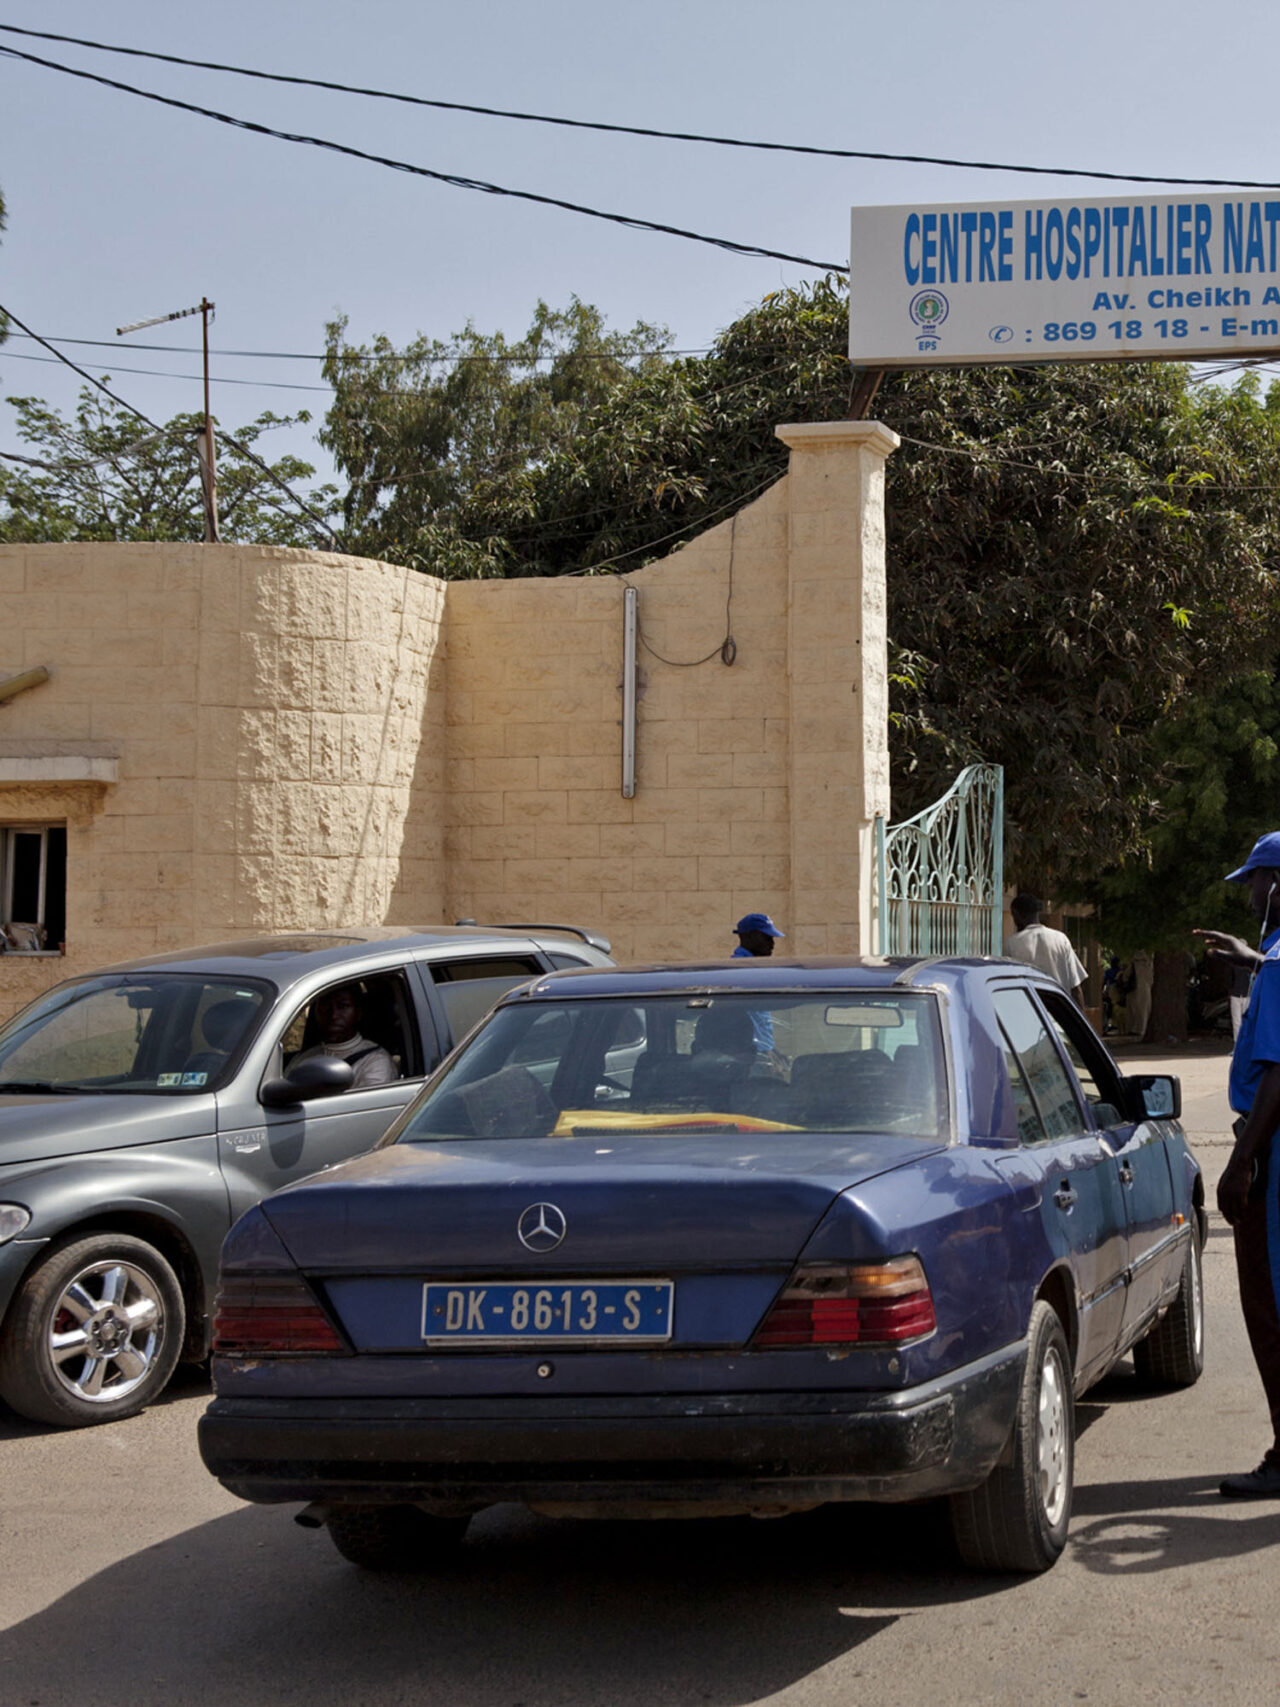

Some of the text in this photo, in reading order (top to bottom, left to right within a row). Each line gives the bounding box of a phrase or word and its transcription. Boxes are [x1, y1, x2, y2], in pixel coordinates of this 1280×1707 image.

[904, 211, 1014, 286] CENTRE
[1024, 203, 1213, 281] HOSPITALIER
[1092, 291, 1137, 311] Av.
[1147, 287, 1251, 310] Cheikh
[1043, 321, 1097, 342] 869
[1107, 320, 1143, 340] 18
[1153, 318, 1189, 339] 18
[918, 340, 937, 351] EPS
[445, 1289, 641, 1331] DK-8613-S
